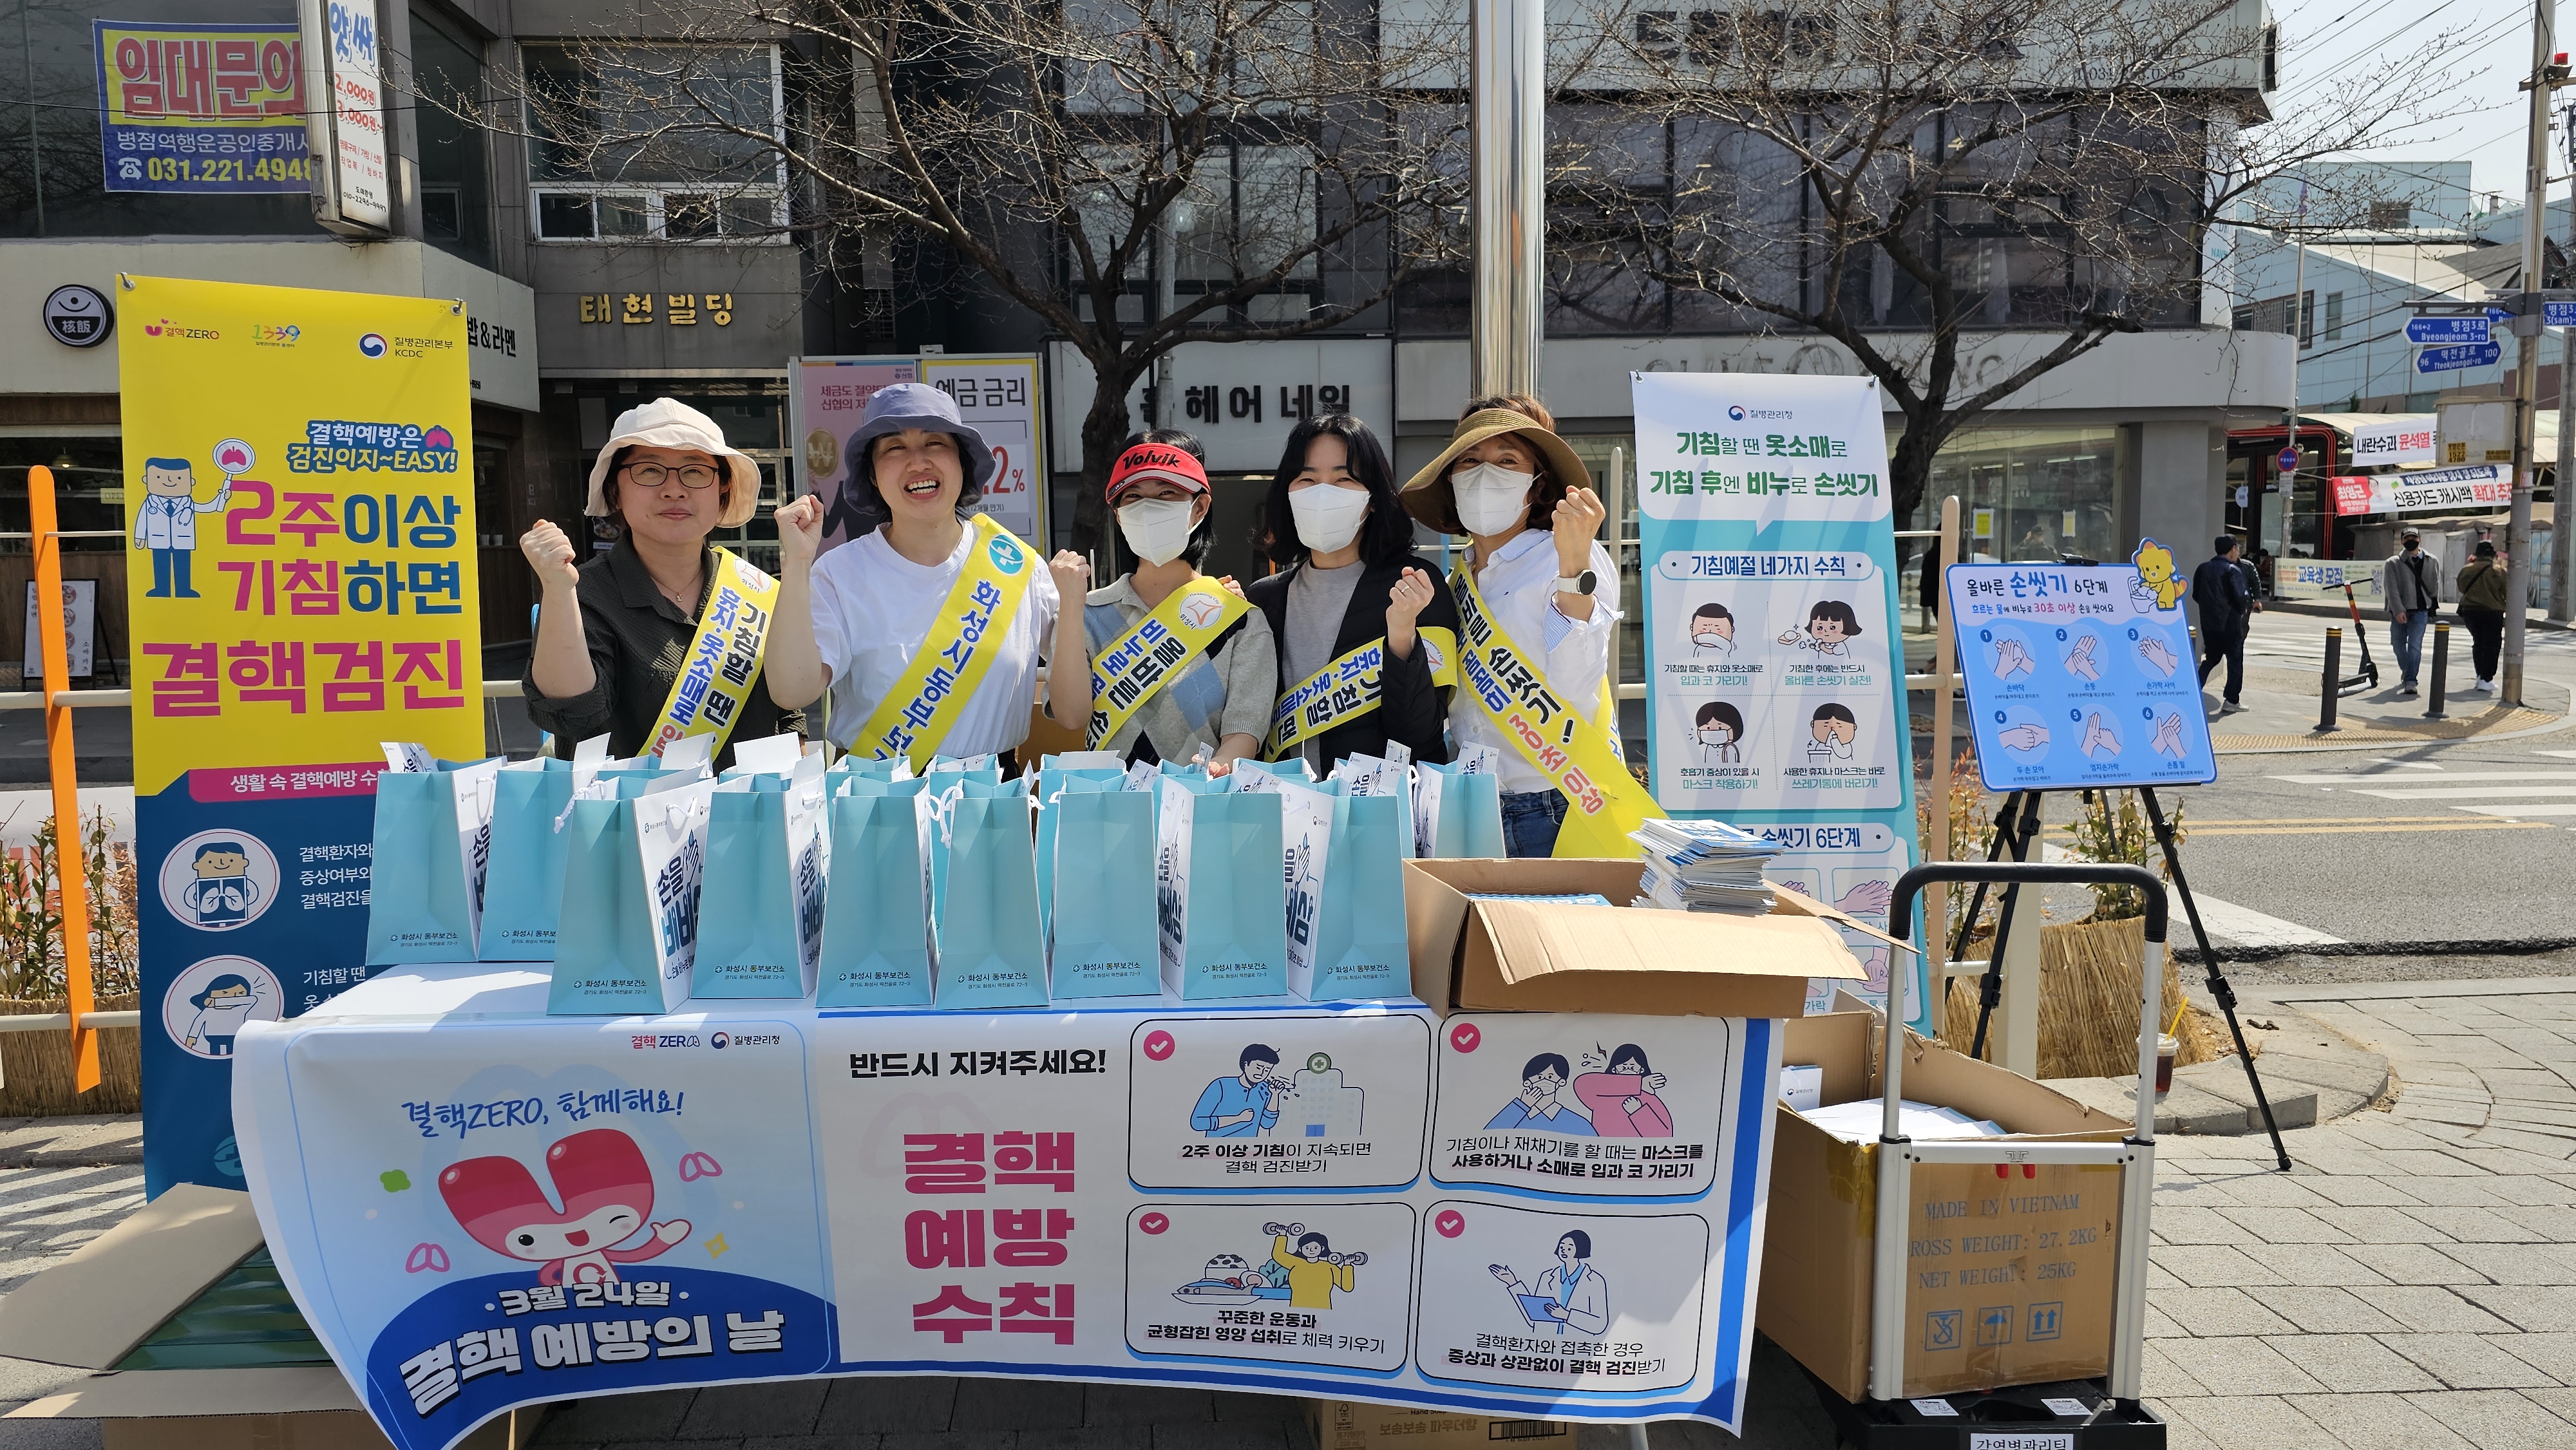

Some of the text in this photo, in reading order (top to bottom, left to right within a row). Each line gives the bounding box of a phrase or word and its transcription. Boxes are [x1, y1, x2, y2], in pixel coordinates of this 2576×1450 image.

[62, 319, 91, 334] 核飯
[2451, 320, 2486, 332] 병점3로
[394, 337, 454, 350] 질병관리본부
[2421, 332, 2486, 343] Byeongjeom 3-ro
[395, 349, 423, 358] KCDC
[2420, 358, 2429, 367] 96
[2441, 346, 2477, 361] 떡전골로
[2485, 348, 2498, 358] 100
[820, 385, 852, 397] 세금도
[983, 377, 1026, 407] 금리
[821, 399, 853, 411] 신협의
[1185, 385, 1262, 424] 헤어
[1749, 409, 1793, 420] 질병관리청
[310, 422, 422, 449] 결핵예방은
[1676, 431, 1848, 458] 기침할 땐 옷소매로
[2356, 431, 2430, 454] 내란수괴 윤석열
[1122, 453, 1181, 471] Volvik
[1649, 469, 1879, 498] 기침 후엔 비누로 손씻기
[2394, 484, 2496, 508] 신용카드 캐시백 확대
[225, 480, 462, 549] 2주이상
[1691, 556, 1845, 577] 기침예절 네가지 수칙
[2298, 565, 2324, 585] 교육생
[2325, 567, 2343, 585] 모집
[218, 559, 463, 616] 기침하면
[1967, 571, 2108, 598] 올바른 손씻기 6단계
[1971, 604, 1994, 615] 흐르는
[2012, 604, 2032, 614] 비누로
[2034, 603, 2055, 613] 30초
[2058, 602, 2076, 614] 이상
[2078, 603, 2090, 614] 손을
[2092, 603, 2115, 614] 씻어요
[720, 601, 767, 687] 기침할
[1101, 619, 1168, 677] 비누로
[142, 639, 466, 717] 결핵검진
[1107, 636, 1187, 711] 올바른
[1664, 664, 1764, 673] 기침할 때는 휴지와 옷소매로
[1680, 675, 1748, 686] 입과 코 가리기!
[2006, 684, 2025, 692] 손바닥
[2146, 681, 2176, 690] 손가락 사이
[1508, 713, 1567, 773] 30초
[1562, 766, 1604, 814] 이상
[1680, 767, 1705, 777] 호흡기
[1706, 767, 1732, 777] 증상이
[1751, 767, 1760, 777] 시
[2090, 763, 2119, 772] 엄지손가락
[230, 773, 267, 793] 생활
[269, 773, 288, 791] 속
[290, 769, 357, 791] 결핵예방
[1682, 778, 1758, 790] 마스크 착용하기!
[1815, 827, 1861, 849] 6단계
[299, 842, 374, 864] 결핵환자와
[401, 932, 459, 941] 화성시 동부보건소
[726, 965, 748, 973] 화성시
[631, 1035, 656, 1050] 결핵
[734, 1034, 781, 1046] 질병관리청
[849, 1049, 1107, 1078] 반드시 지켜주세요!
[556, 1088, 685, 1123] 함께해요!
[1182, 1142, 1371, 1158] 2주 이상 기침이 지속되면
[1446, 1136, 1704, 1160] 기침이나 재채기를 할 때는 마스크를
[903, 1131, 1075, 1194] 결핵
[1226, 1160, 1327, 1174] 결핵 검진받기
[1452, 1153, 1694, 1178] 사용하거나 소매로 입과 코 가리기
[1924, 1194, 2080, 1219] MADE IN VIETNAM
[904, 1209, 1075, 1270] 예방
[1908, 1238, 1952, 1258] ROSS
[1962, 1234, 2029, 1254] WEIGHT:
[1918, 1261, 2077, 1289] NET WEIGHT: 25KG
[498, 1281, 671, 1316] 3월 24일
[913, 1282, 1075, 1346] 수칙
[399, 1309, 786, 1418] 결핵 예방의 날
[1379, 1420, 1426, 1436] 보송보송
